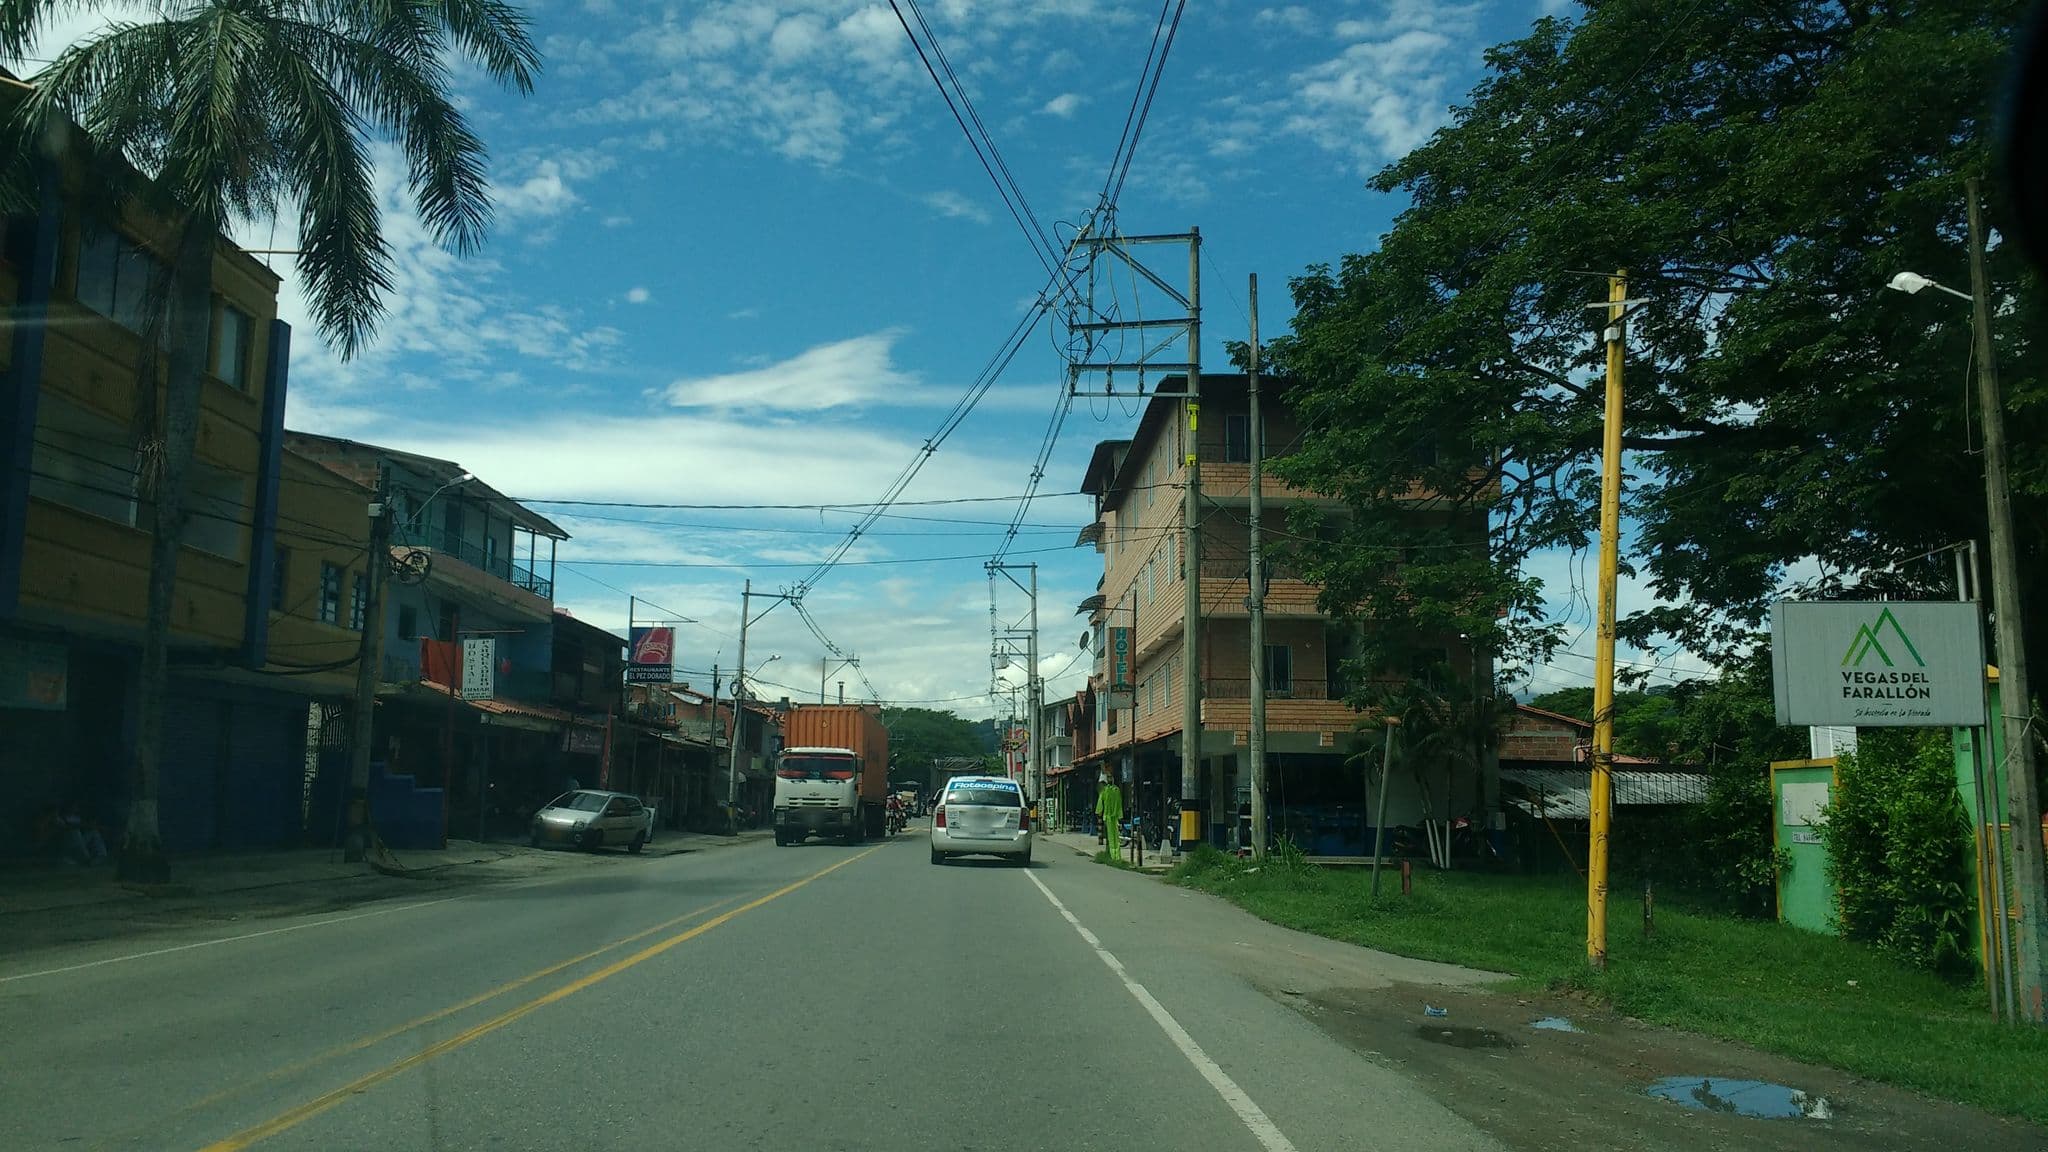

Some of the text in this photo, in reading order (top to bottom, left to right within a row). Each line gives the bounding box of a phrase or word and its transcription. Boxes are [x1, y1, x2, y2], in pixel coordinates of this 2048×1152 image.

[1115, 627, 1128, 687] HOTEL
[1842, 671, 1930, 684] VEGAS DEL
[1843, 684, 1931, 699] FARALLÓN
